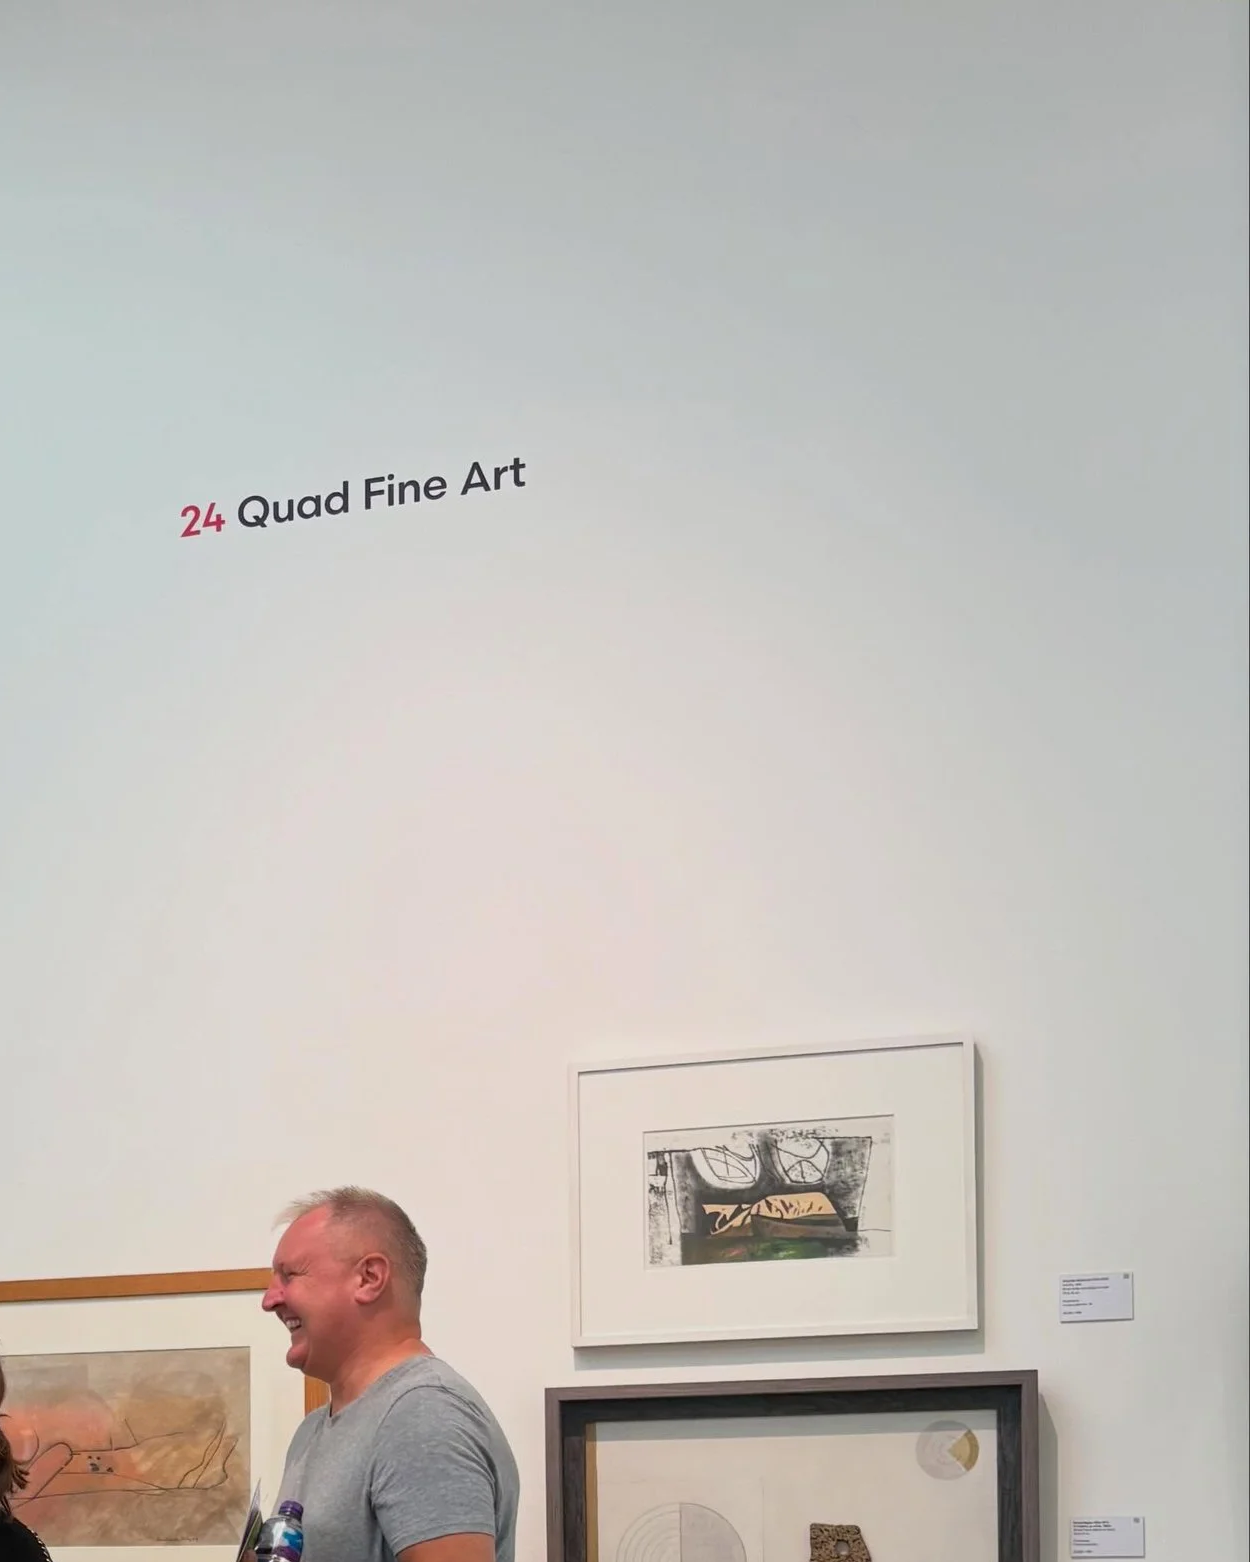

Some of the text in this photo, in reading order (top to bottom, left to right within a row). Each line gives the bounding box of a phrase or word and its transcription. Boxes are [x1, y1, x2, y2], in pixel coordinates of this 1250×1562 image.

[180, 457, 527, 538] 24 Quad Fine Art
